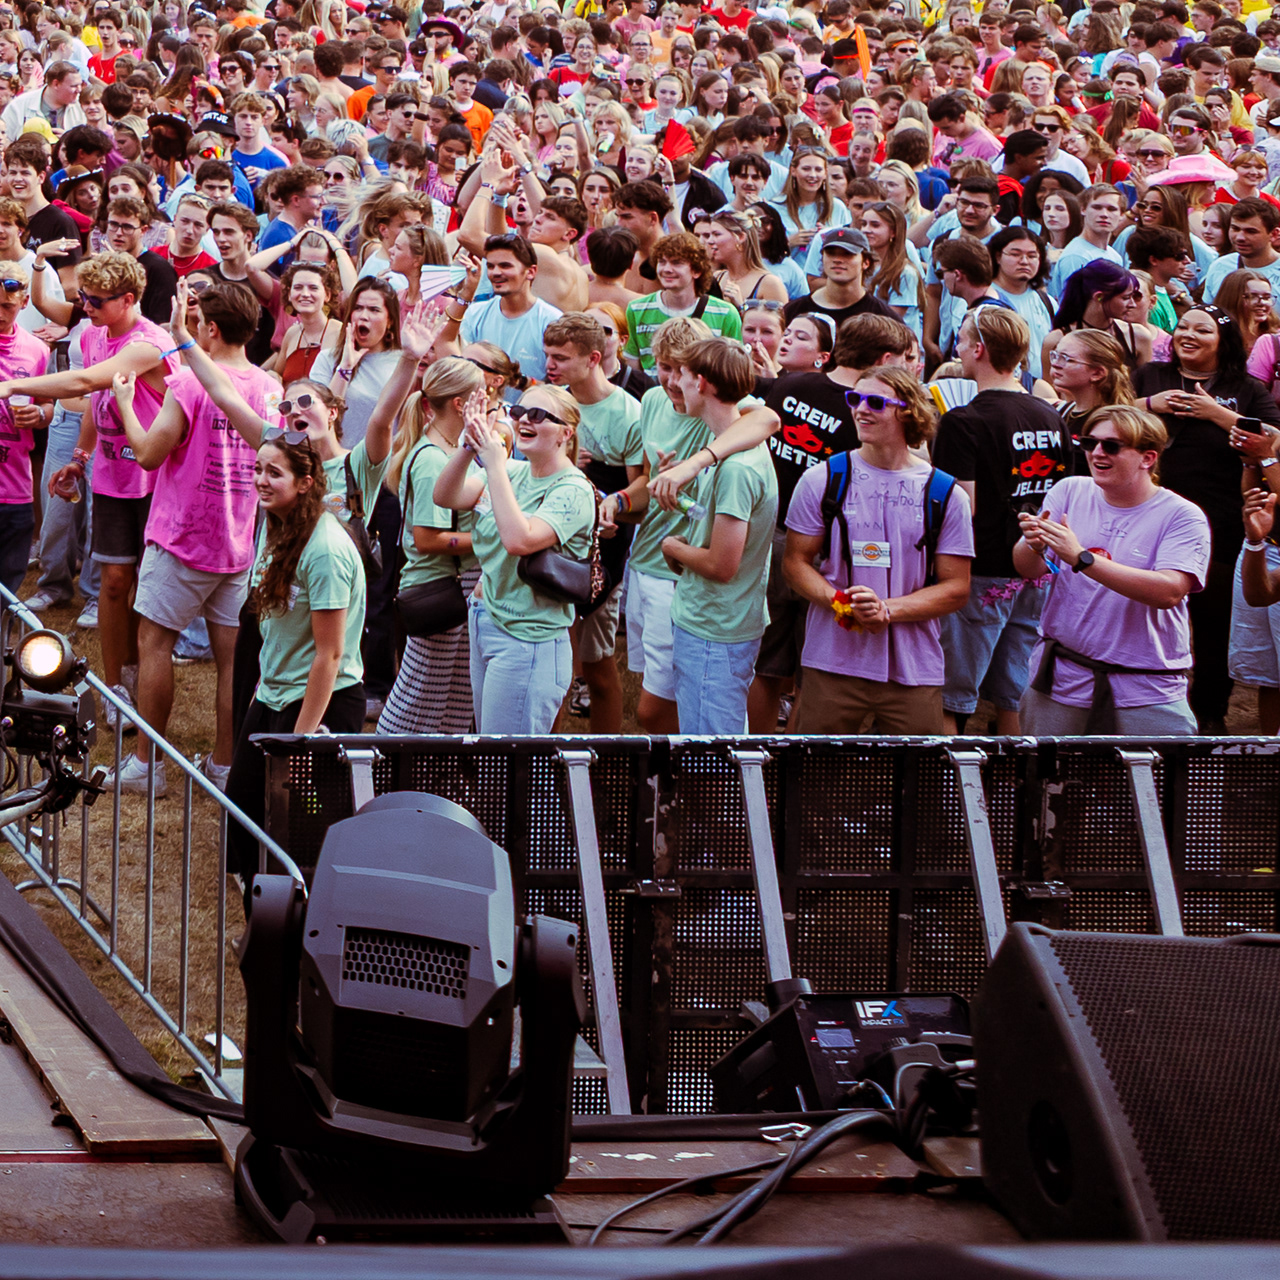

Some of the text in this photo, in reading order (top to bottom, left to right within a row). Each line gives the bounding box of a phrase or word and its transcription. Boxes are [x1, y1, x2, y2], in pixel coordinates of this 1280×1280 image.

[783, 396, 842, 434] CREW
[1012, 431, 1061, 451] CREW
[770, 435, 823, 468] PIETE
[1012, 479, 1053, 497] JELLE
[855, 1001, 902, 1018] IFX
